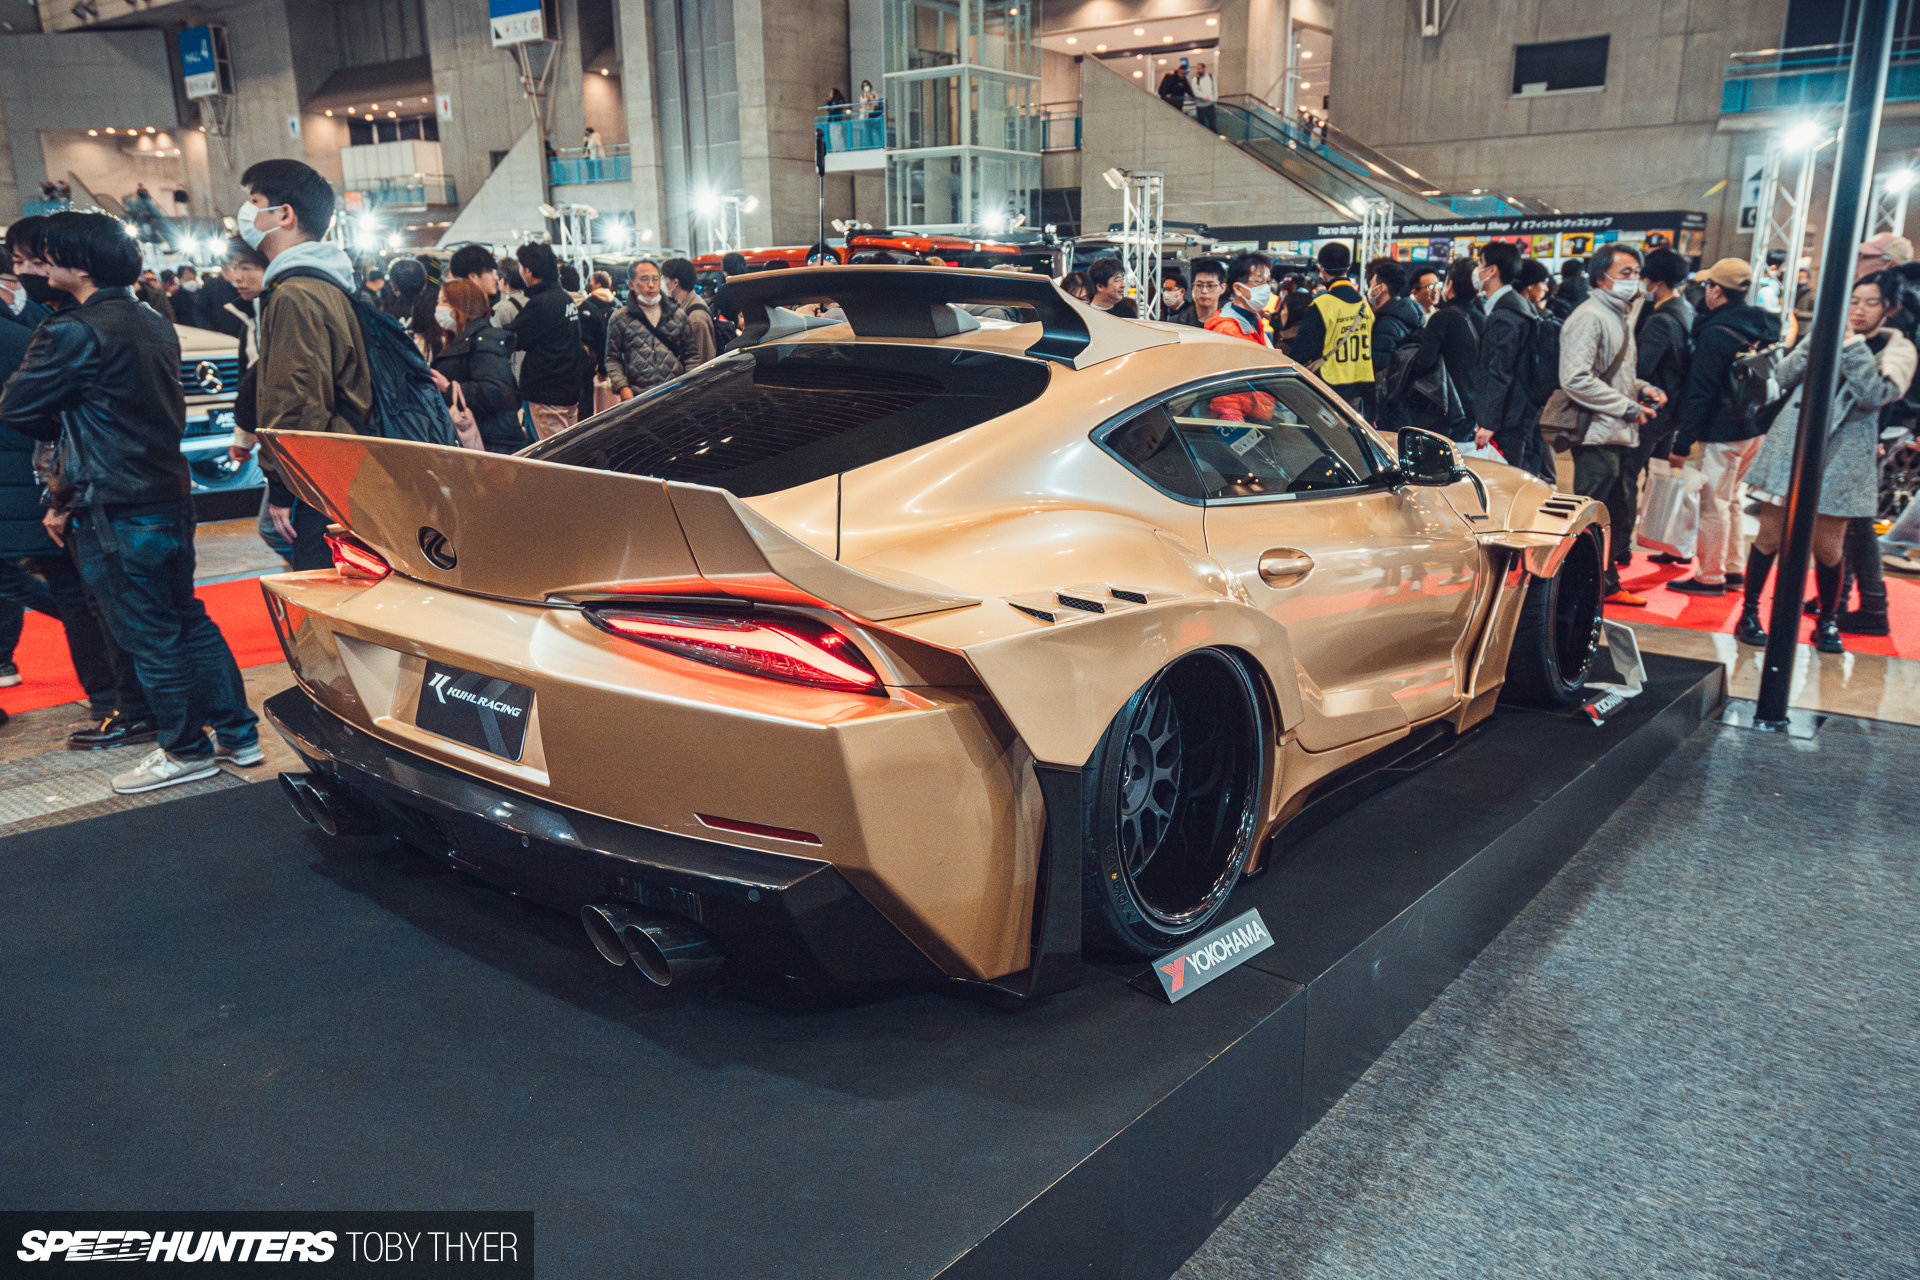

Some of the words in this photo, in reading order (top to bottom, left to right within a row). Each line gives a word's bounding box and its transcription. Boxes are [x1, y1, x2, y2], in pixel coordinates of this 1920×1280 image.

[1402, 223, 1432, 234] Official
[1433, 221, 1486, 232] Merchandise
[1487, 220, 1511, 231] Shop
[1336, 335, 1372, 363] 005
[1104, 843, 1130, 910] YOKOAMA
[1185, 920, 1267, 975] YOKOHAMA
